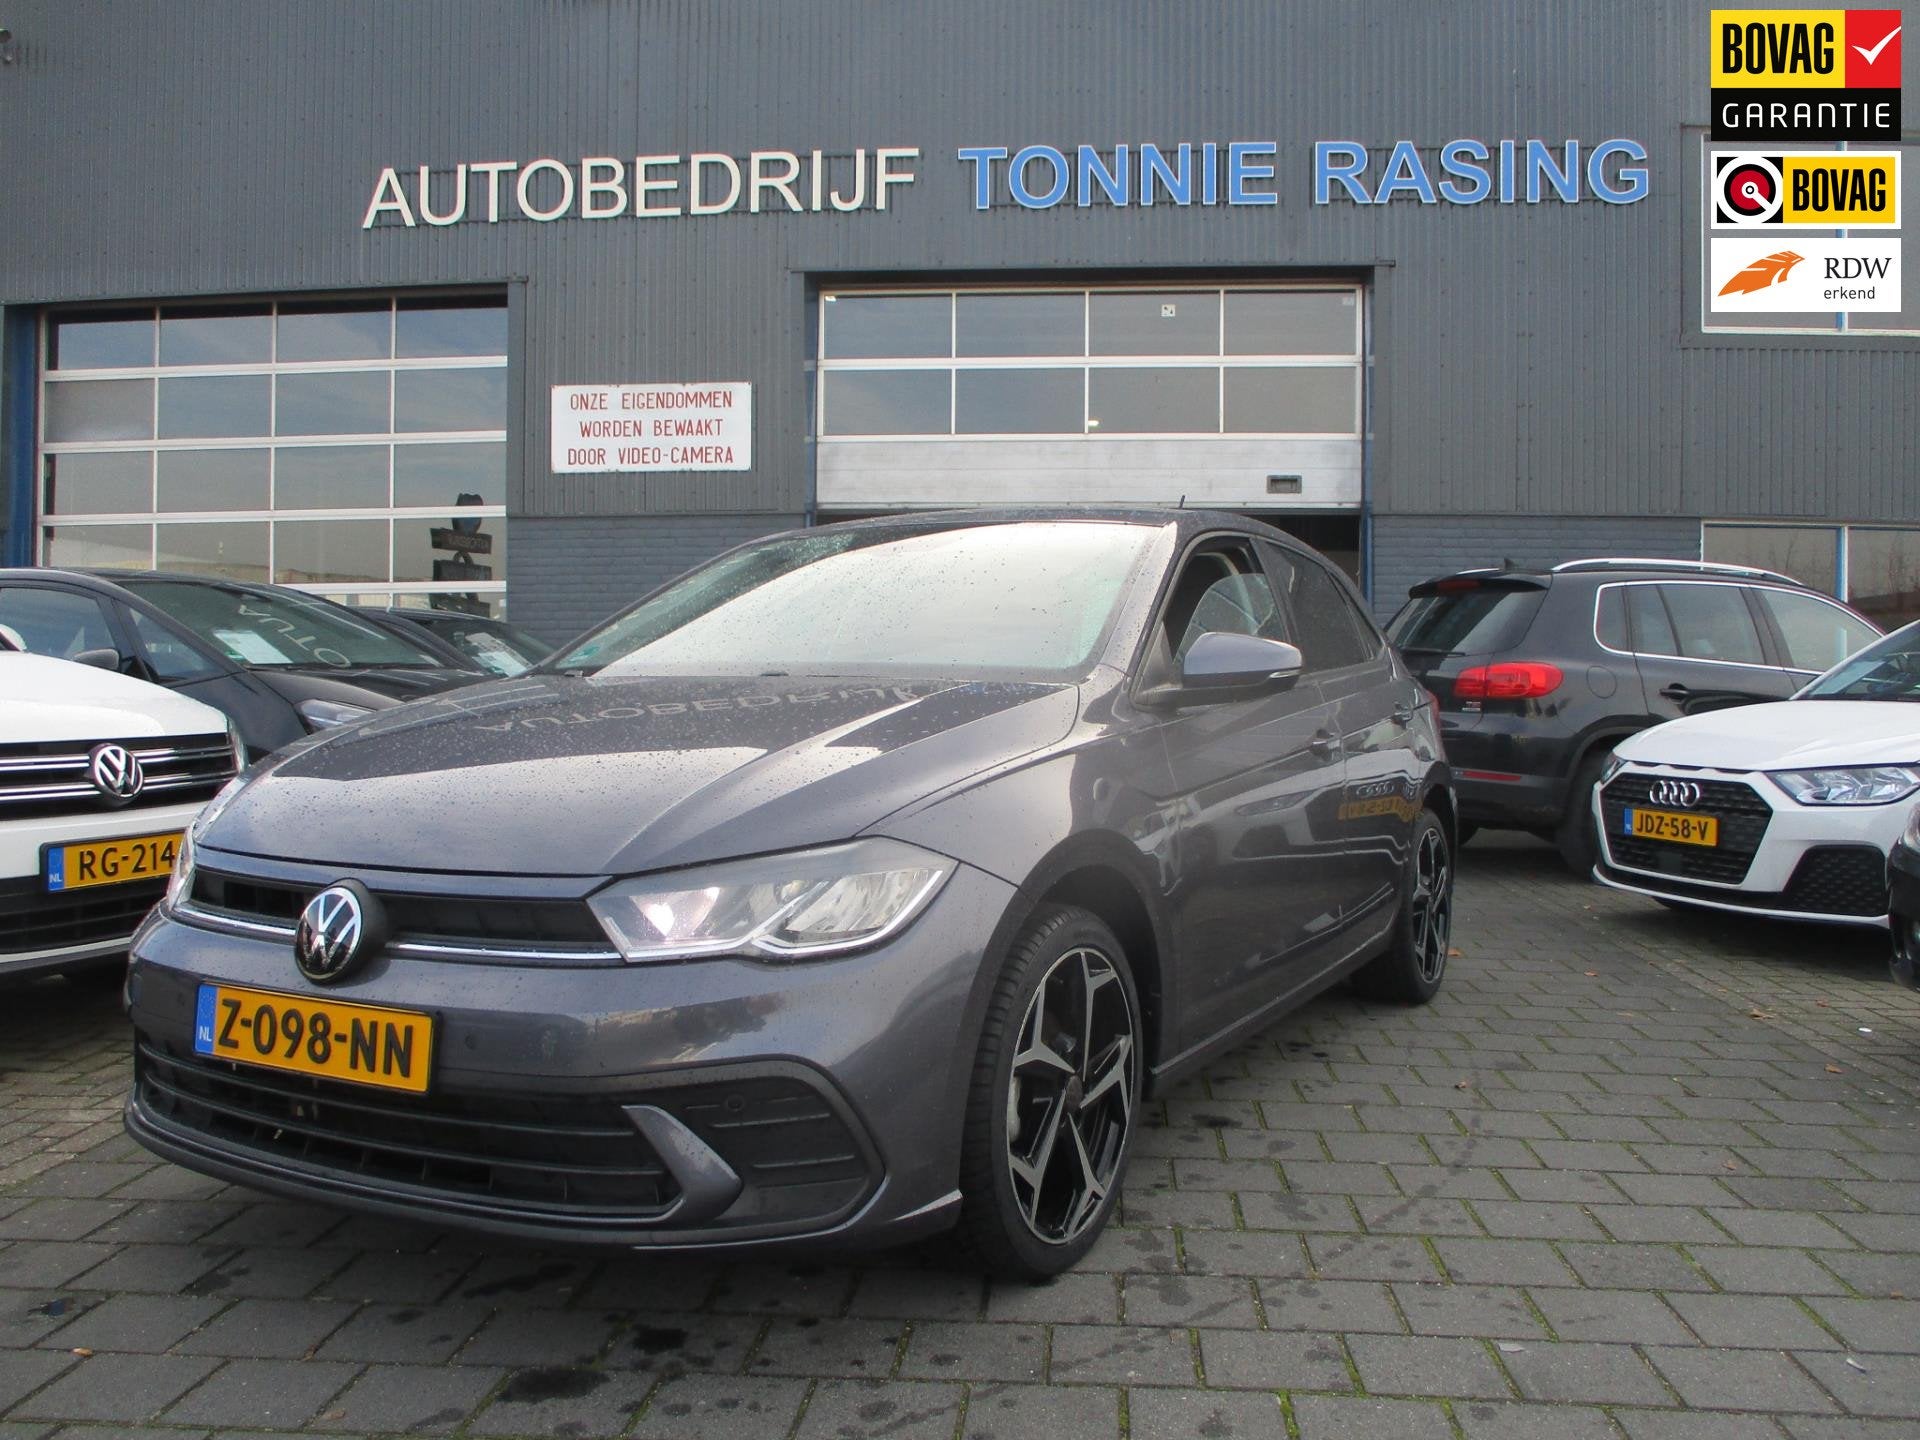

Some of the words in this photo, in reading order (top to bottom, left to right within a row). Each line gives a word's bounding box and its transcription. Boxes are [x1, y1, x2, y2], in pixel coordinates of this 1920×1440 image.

[363, 147, 919, 229] AUTOBEDRIJF
[957, 141, 1278, 209] TONNIE
[1314, 139, 1649, 205] RASING
[570, 393, 609, 410] ONZE
[621, 390, 733, 410] EIGENDOMMEN
[579, 420, 642, 438] WORDEN
[653, 418, 723, 437] BEWAAKT
[567, 448, 606, 466] DOOR
[618, 446, 734, 465] VIDEO-CAMERA
[1636, 813, 1709, 841] JDZ-58-V
[50, 873, 62, 883] NL
[199, 1025, 213, 1043] NL
[218, 997, 414, 1079] Z-098-NN
